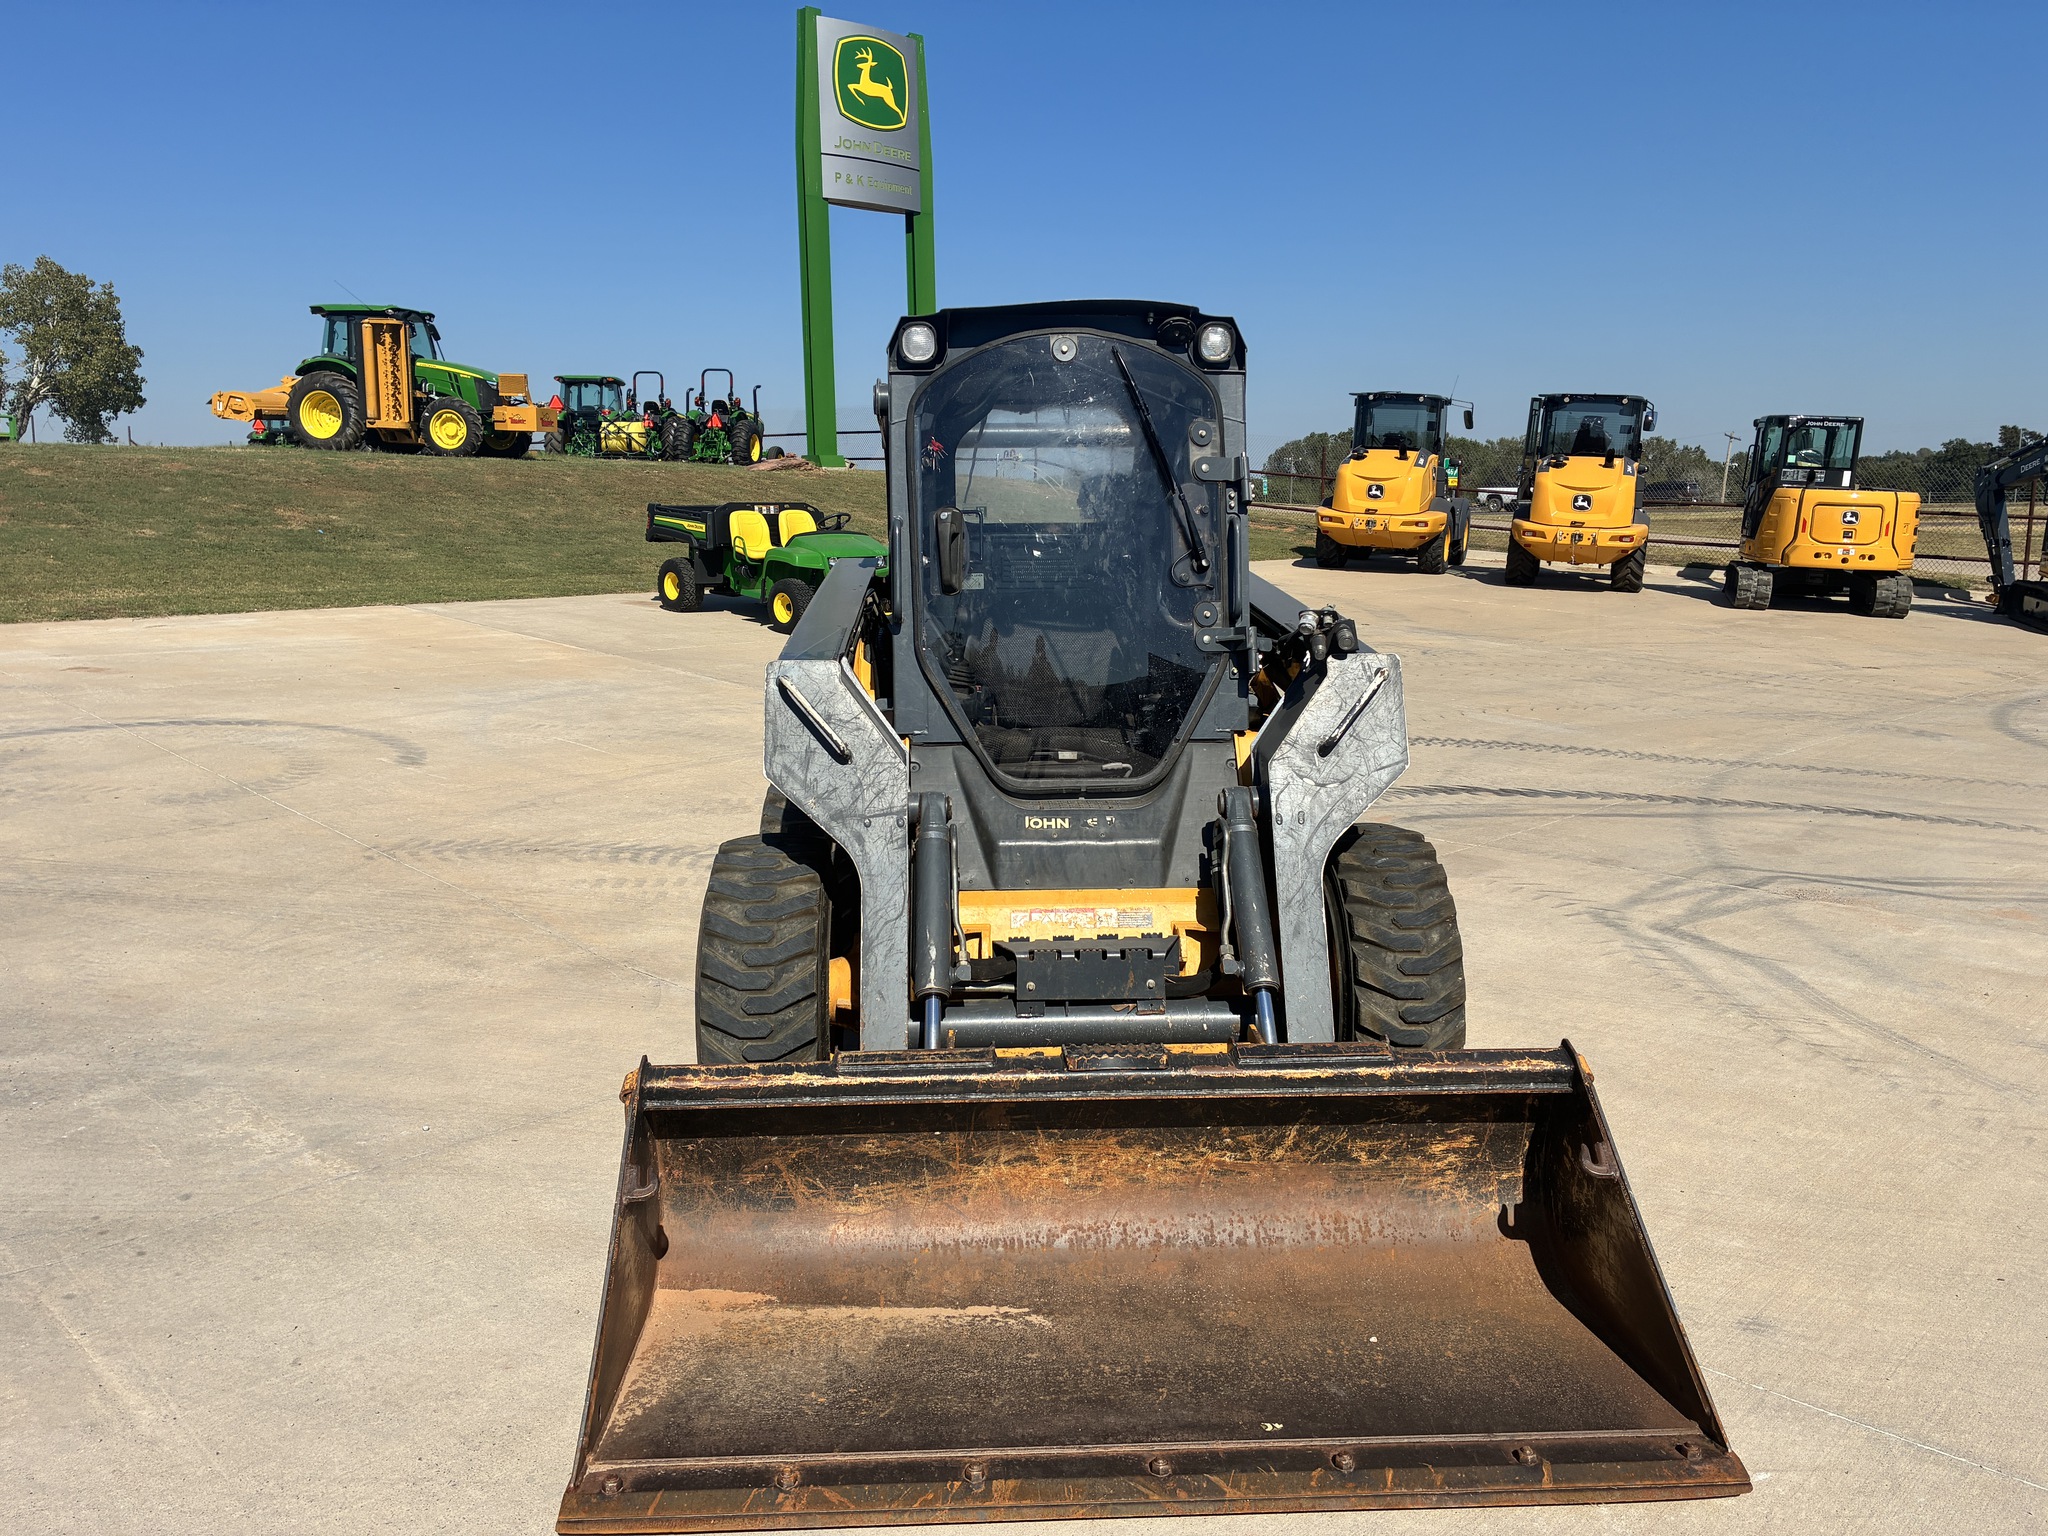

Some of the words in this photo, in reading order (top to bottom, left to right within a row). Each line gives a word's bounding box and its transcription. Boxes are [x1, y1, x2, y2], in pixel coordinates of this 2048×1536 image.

[834, 136, 872, 153] JOHN
[873, 141, 912, 161] DEERE
[835, 172, 842, 183] P
[845, 173, 853, 185] &
[857, 175, 865, 187] K
[867, 176, 913, 195] Equipment
[2021, 458, 2040, 473] DEERE
